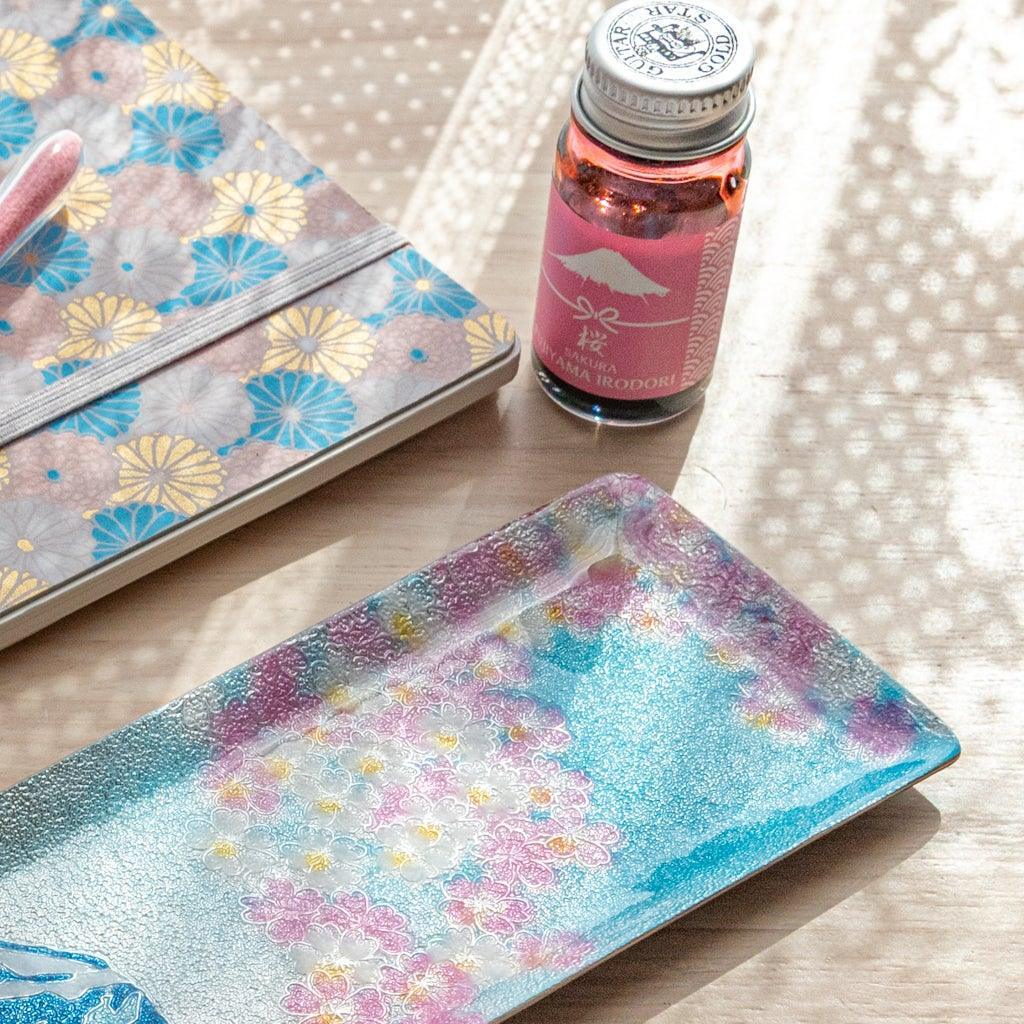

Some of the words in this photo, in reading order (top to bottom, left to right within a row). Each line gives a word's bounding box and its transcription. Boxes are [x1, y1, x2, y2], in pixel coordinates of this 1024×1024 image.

[647, 5, 711, 25] STAR
[613, 26, 664, 76] GUITAR
[698, 35, 731, 74] GOLD
[577, 325, 607, 357] 桜
[564, 347, 617, 375] SAKURA
[596, 373, 676, 391] IRODORI
